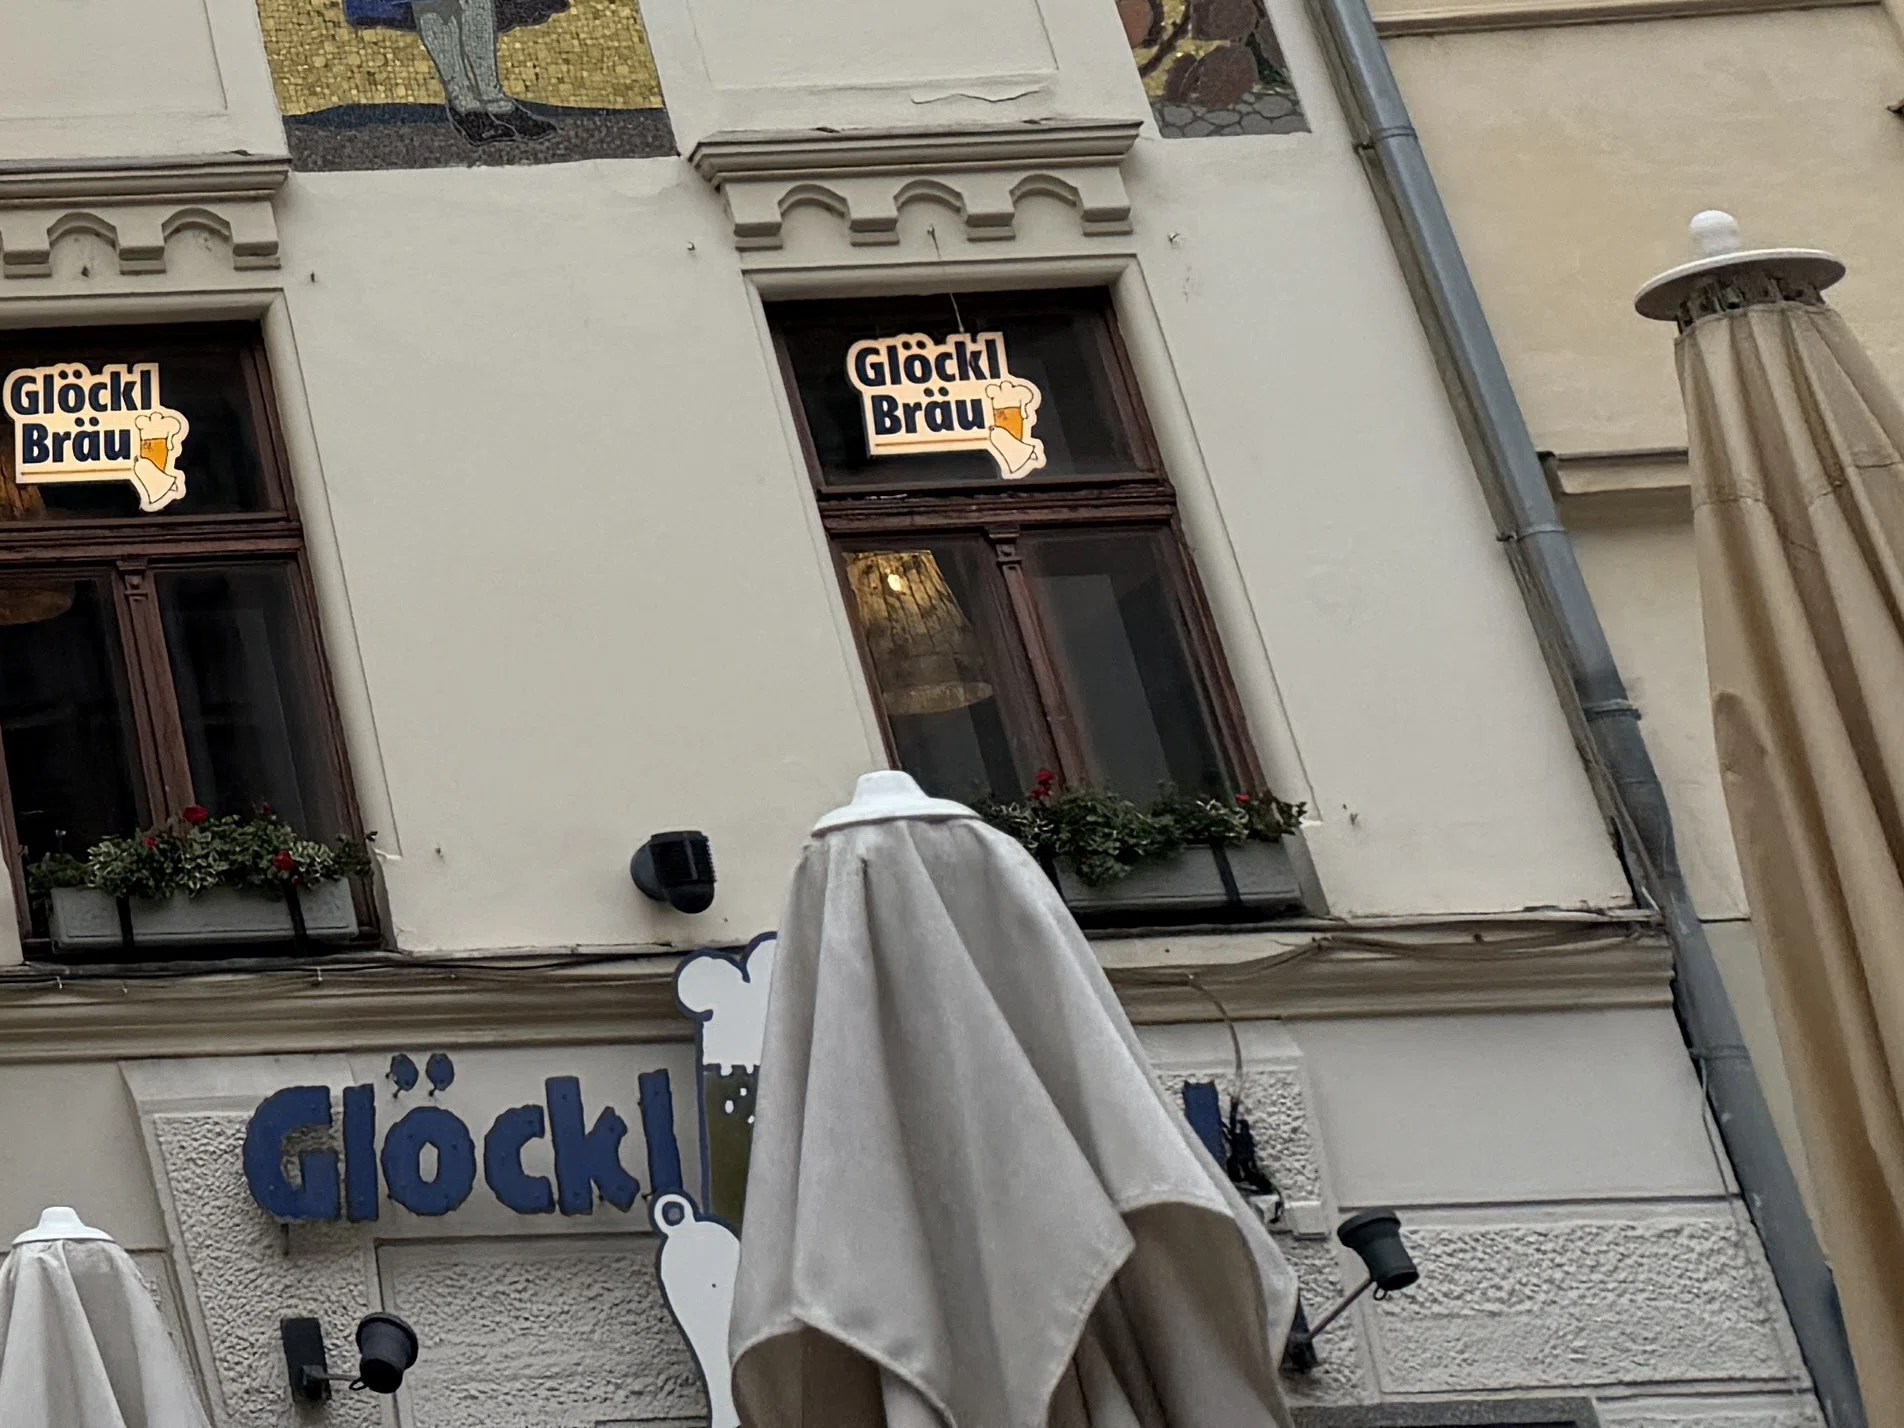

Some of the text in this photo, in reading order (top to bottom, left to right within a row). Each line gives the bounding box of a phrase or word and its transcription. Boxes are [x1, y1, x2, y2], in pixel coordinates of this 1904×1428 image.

[854, 338, 1002, 387] Glöckl
[10, 369, 152, 415] Glöckl
[870, 387, 986, 435] Bräu
[22, 416, 131, 464] Bräu
[243, 1052, 683, 1223] Glöckl
